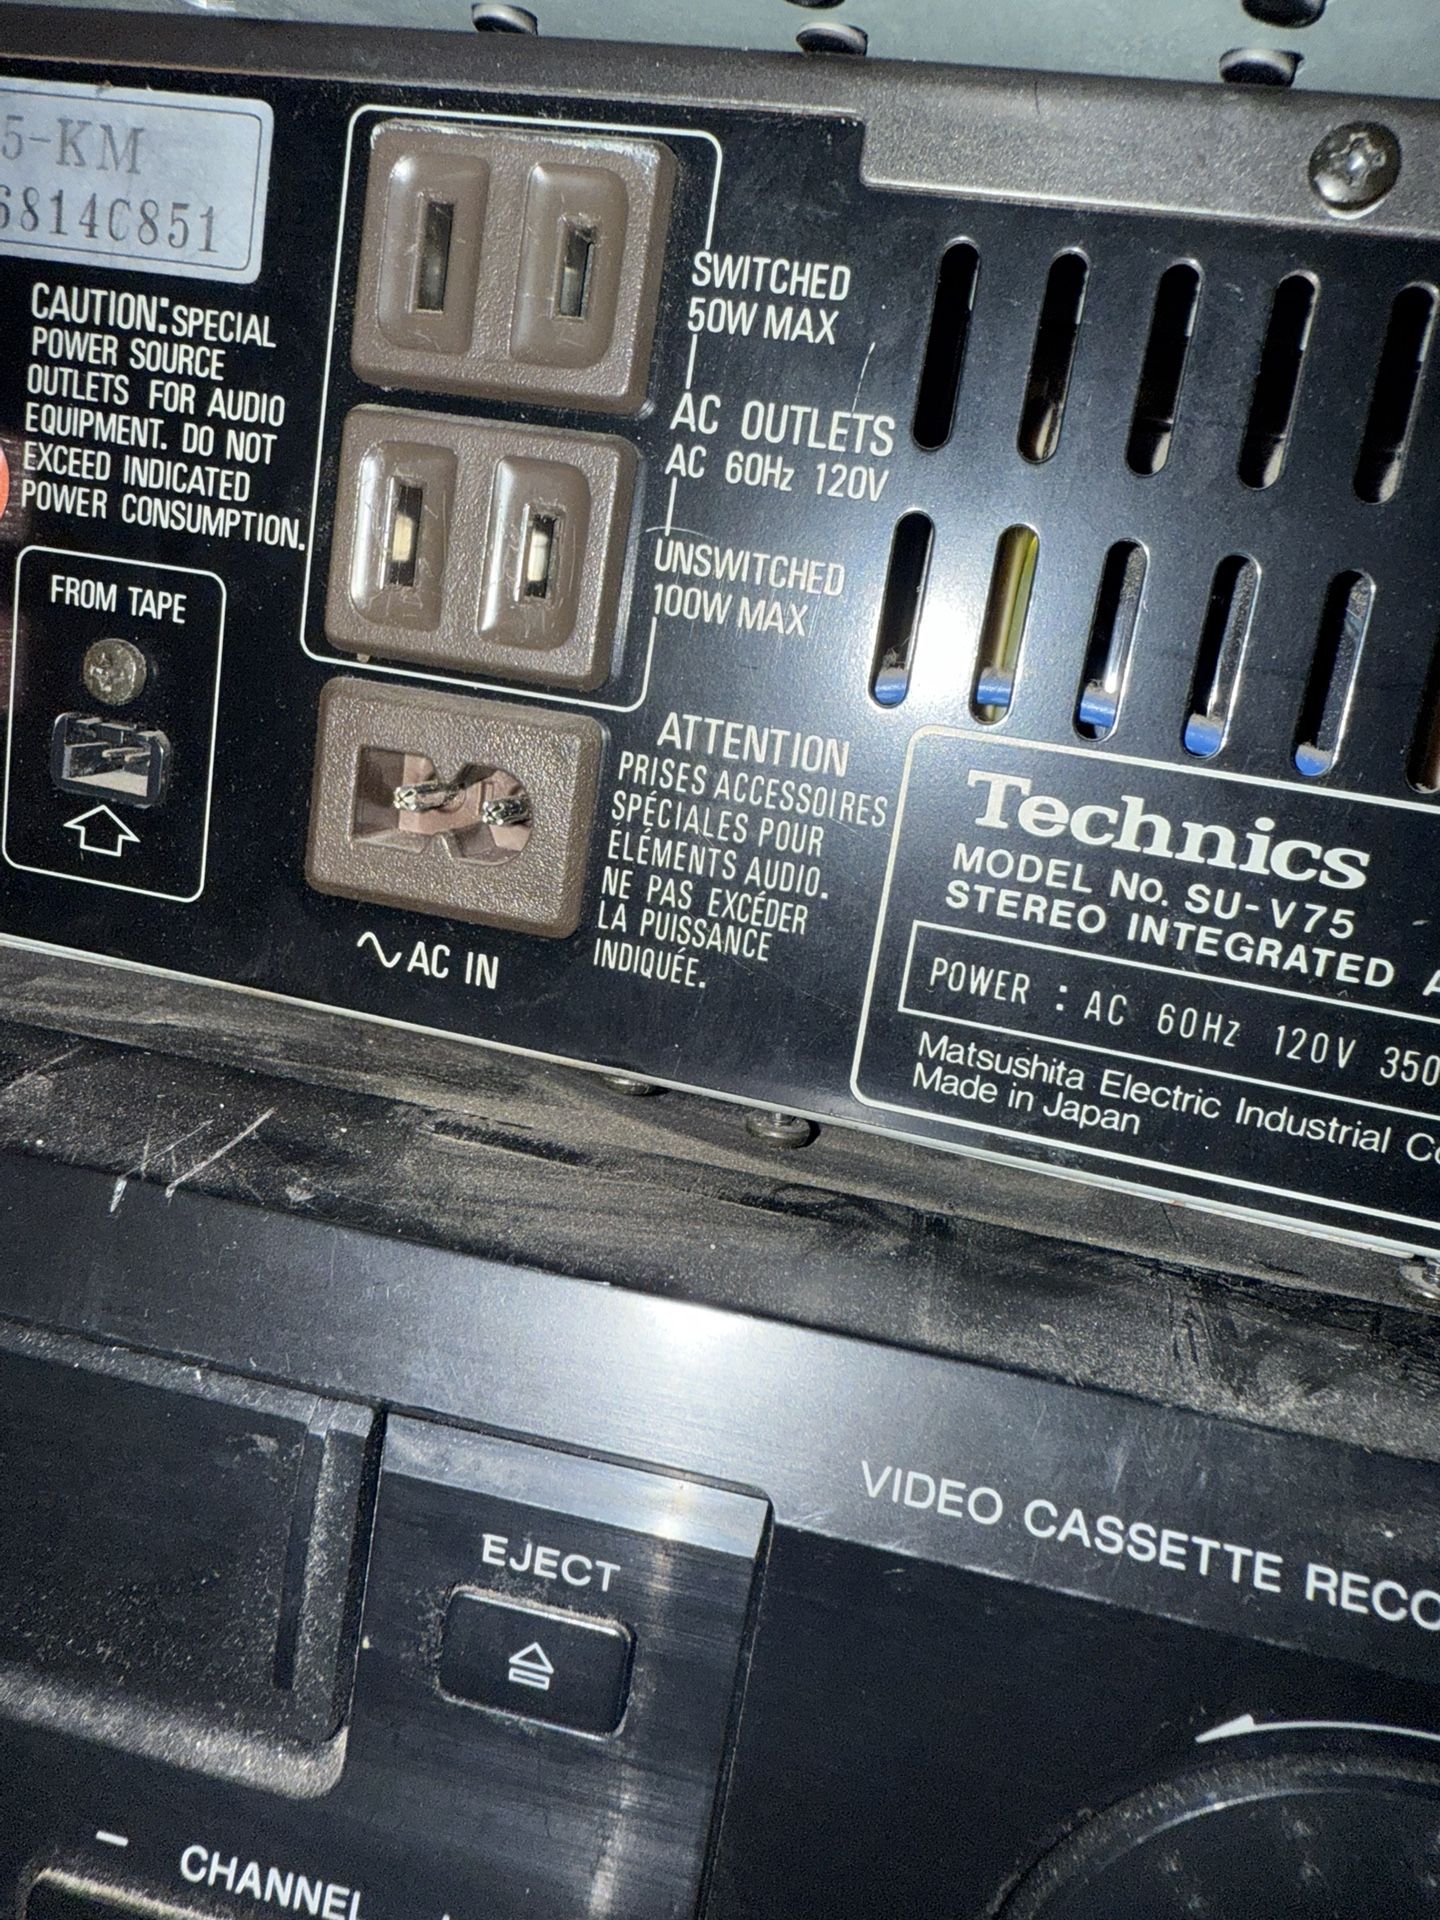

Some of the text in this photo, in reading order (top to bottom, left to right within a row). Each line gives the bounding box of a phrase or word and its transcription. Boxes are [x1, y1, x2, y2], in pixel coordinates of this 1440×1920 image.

[2, 115, 145, 174] 5-KM
[692, 251, 851, 301] SWITCHED
[172, 305, 276, 348] SPECIAL
[687, 296, 839, 345] 50W MAX
[32, 327, 226, 380] POWER SOURCE
[27, 364, 285, 427] OUTLETS FOR AUDIO
[670, 392, 896, 457] AC OUTLETS
[25, 403, 278, 465] EQUIPMENT. DO NOT
[23, 441, 250, 503] EXCEED INDICATED
[665, 443, 889, 501] AC 60Hz 120V
[21, 480, 305, 551] POWER CONSUMPTION.
[654, 538, 845, 596] UNSWITCHED
[51, 574, 187, 624] FROM TAPE
[654, 583, 808, 636] 100W MAX
[657, 712, 849, 777] ATTENTION
[618, 751, 888, 827] PRISES ACCESSOIRES
[611, 789, 824, 857] SPÉCIALES POUR
[967, 769, 1371, 889] Technics
[607, 822, 828, 900] ÉLÉMENTS AUDIO.
[953, 842, 1356, 939] MODEL No. SU-V75
[598, 901, 772, 962] LA PUISSANCE
[602, 866, 808, 935] NE PAS EXCÉDER
[407, 941, 499, 989] AC IN
[593, 938, 705, 988] INDIQUÉE.
[946, 880, 1106, 934] STEREO
[1128, 913, 1395, 988] INTEGRATED
[930, 958, 1031, 1005] POWER
[1084, 990, 1128, 1026] AC
[1274, 1025, 1357, 1069] 120V
[1380, 1046, 1440, 1086] 350
[912, 1062, 1141, 1135] Made in Japan
[918, 1031, 1440, 1165] Matsushita Electric Industrial C
[482, 1533, 621, 1592] EJECT
[860, 1460, 1440, 1631] VIDEO CASSETTE RECO
